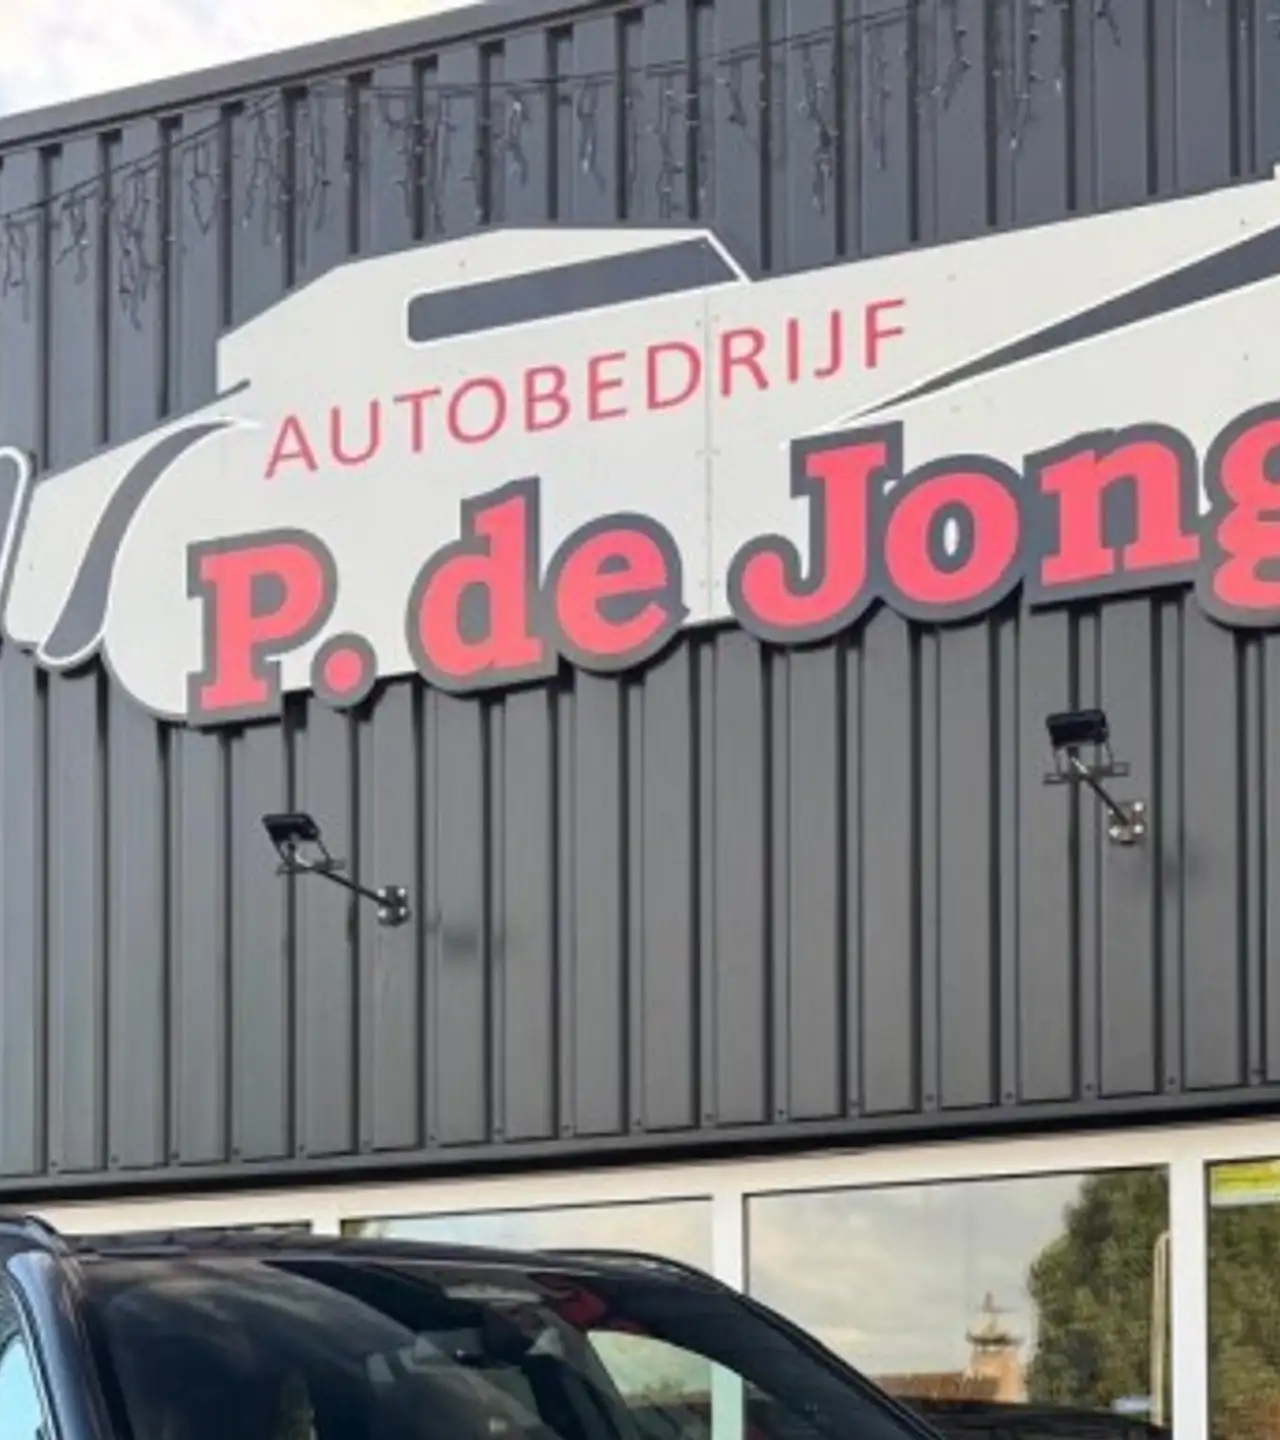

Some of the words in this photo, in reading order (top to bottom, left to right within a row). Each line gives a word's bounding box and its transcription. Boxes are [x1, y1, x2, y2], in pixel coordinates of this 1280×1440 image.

[264, 298, 908, 481] AUTOBEDRIJF
[190, 542, 376, 710] P.
[419, 496, 668, 678] de
